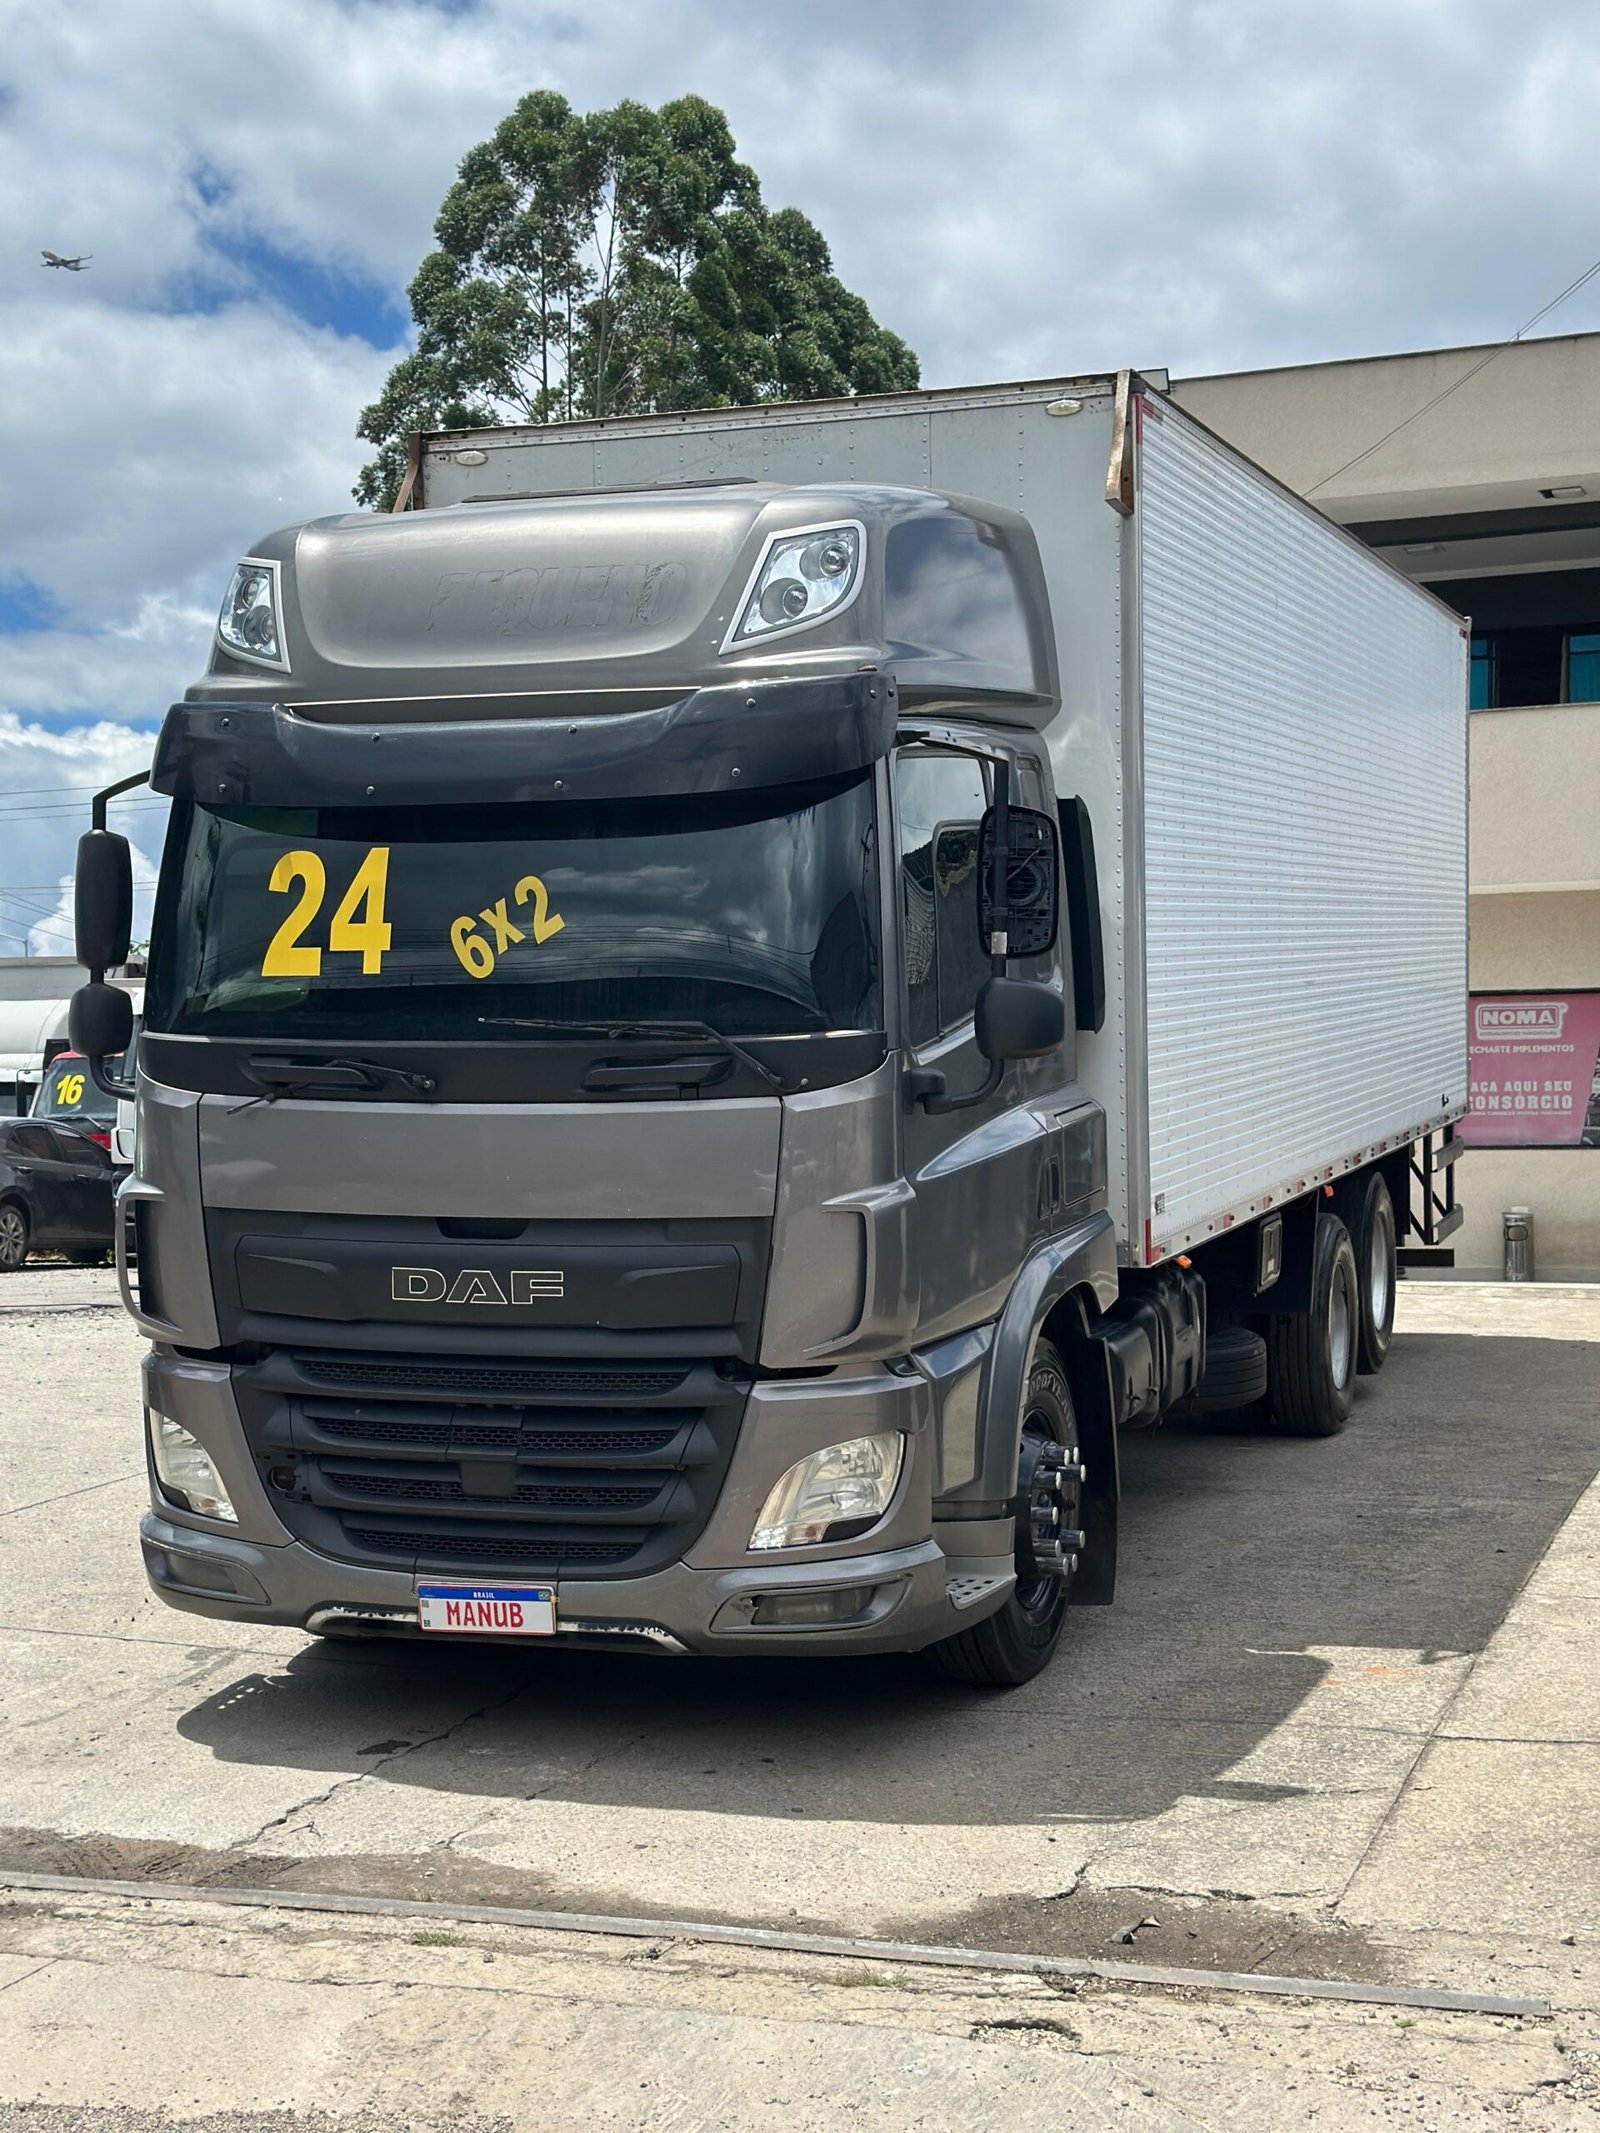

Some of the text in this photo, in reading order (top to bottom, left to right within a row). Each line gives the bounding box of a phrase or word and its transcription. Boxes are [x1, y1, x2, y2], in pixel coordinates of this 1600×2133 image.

[262, 847, 391, 976] 24
[1482, 1010, 1555, 1025] NOMA
[1469, 1044, 1575, 1054] ECHARTE IMPLEMENTOS
[57, 1074, 86, 1105] 16
[1470, 1081, 1572, 1096] AÇA AQUI SEU
[391, 1266, 564, 1305] DAF
[1029, 1372, 1072, 1429] OODYEAR
[473, 1591, 495, 1599] BRASIL
[445, 1600, 524, 1628] MANUB
